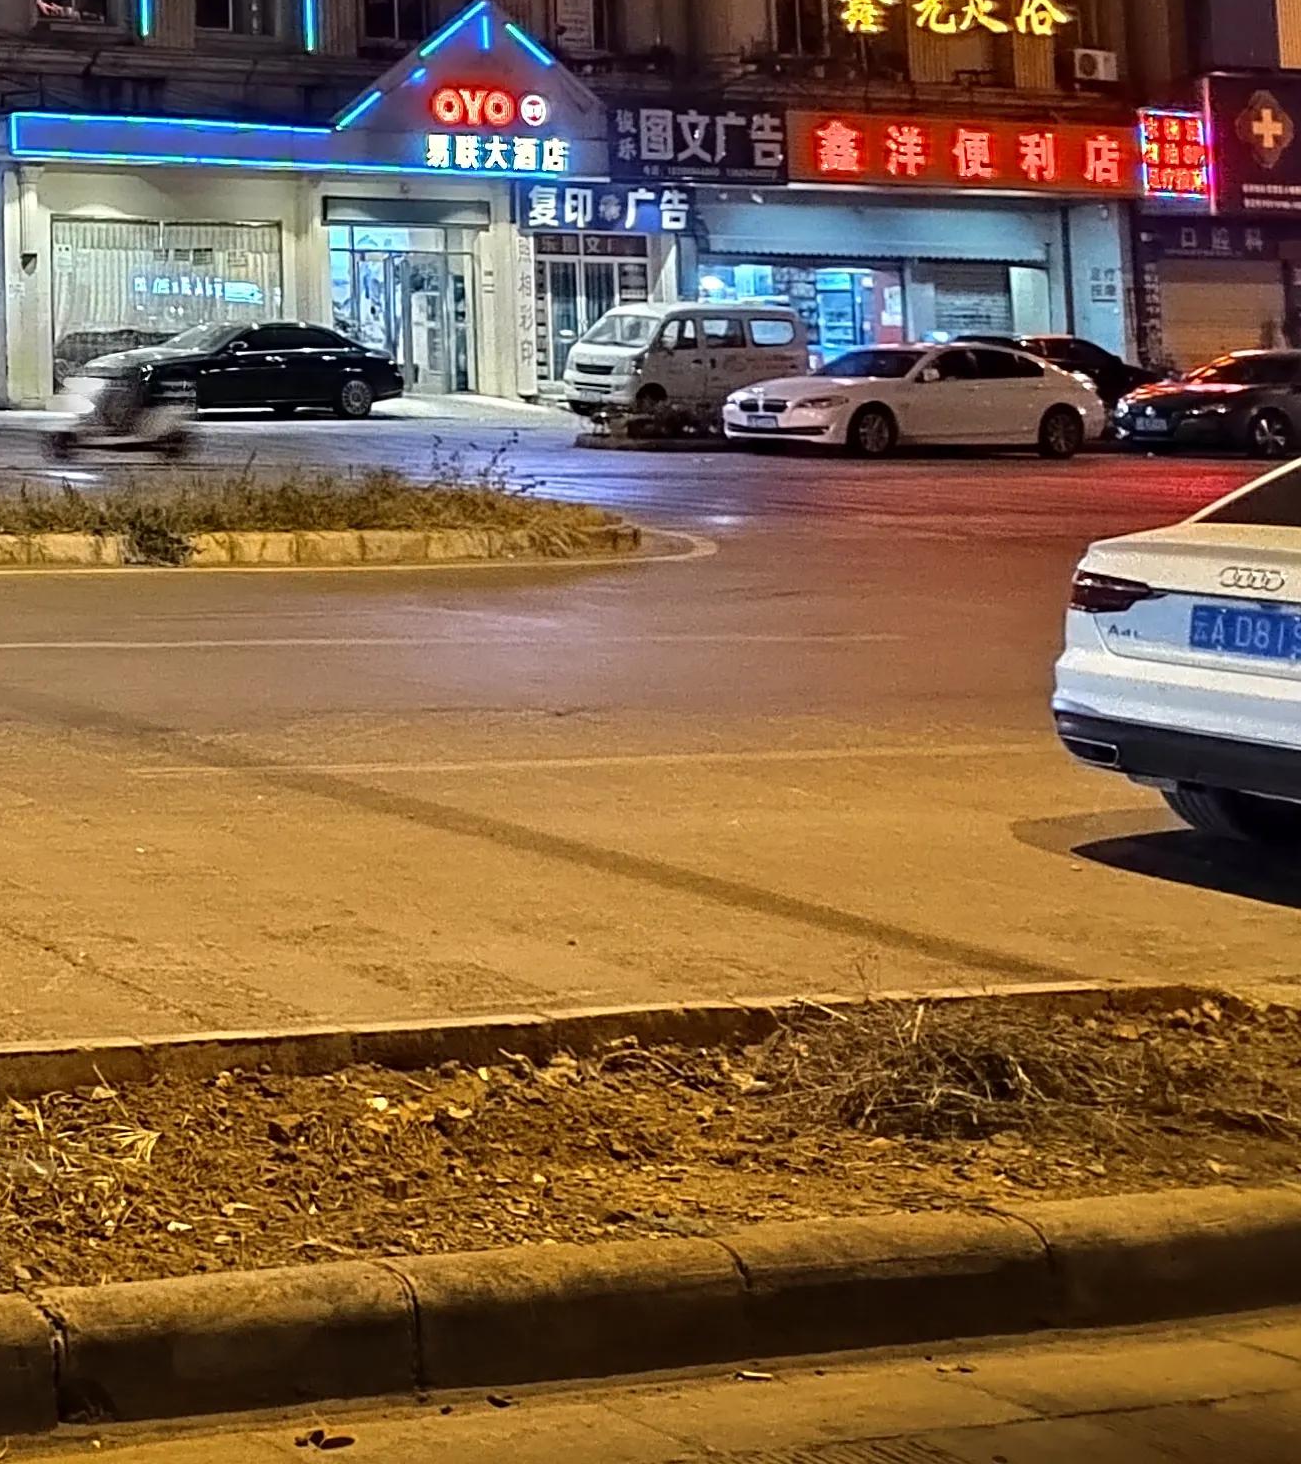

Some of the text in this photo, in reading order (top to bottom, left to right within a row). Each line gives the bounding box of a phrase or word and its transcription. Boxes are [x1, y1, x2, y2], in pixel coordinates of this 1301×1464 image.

[434, 88, 516, 125] OYO
[639, 108, 784, 167] 图文广告
[816, 120, 1121, 184] 鑫洋便利店
